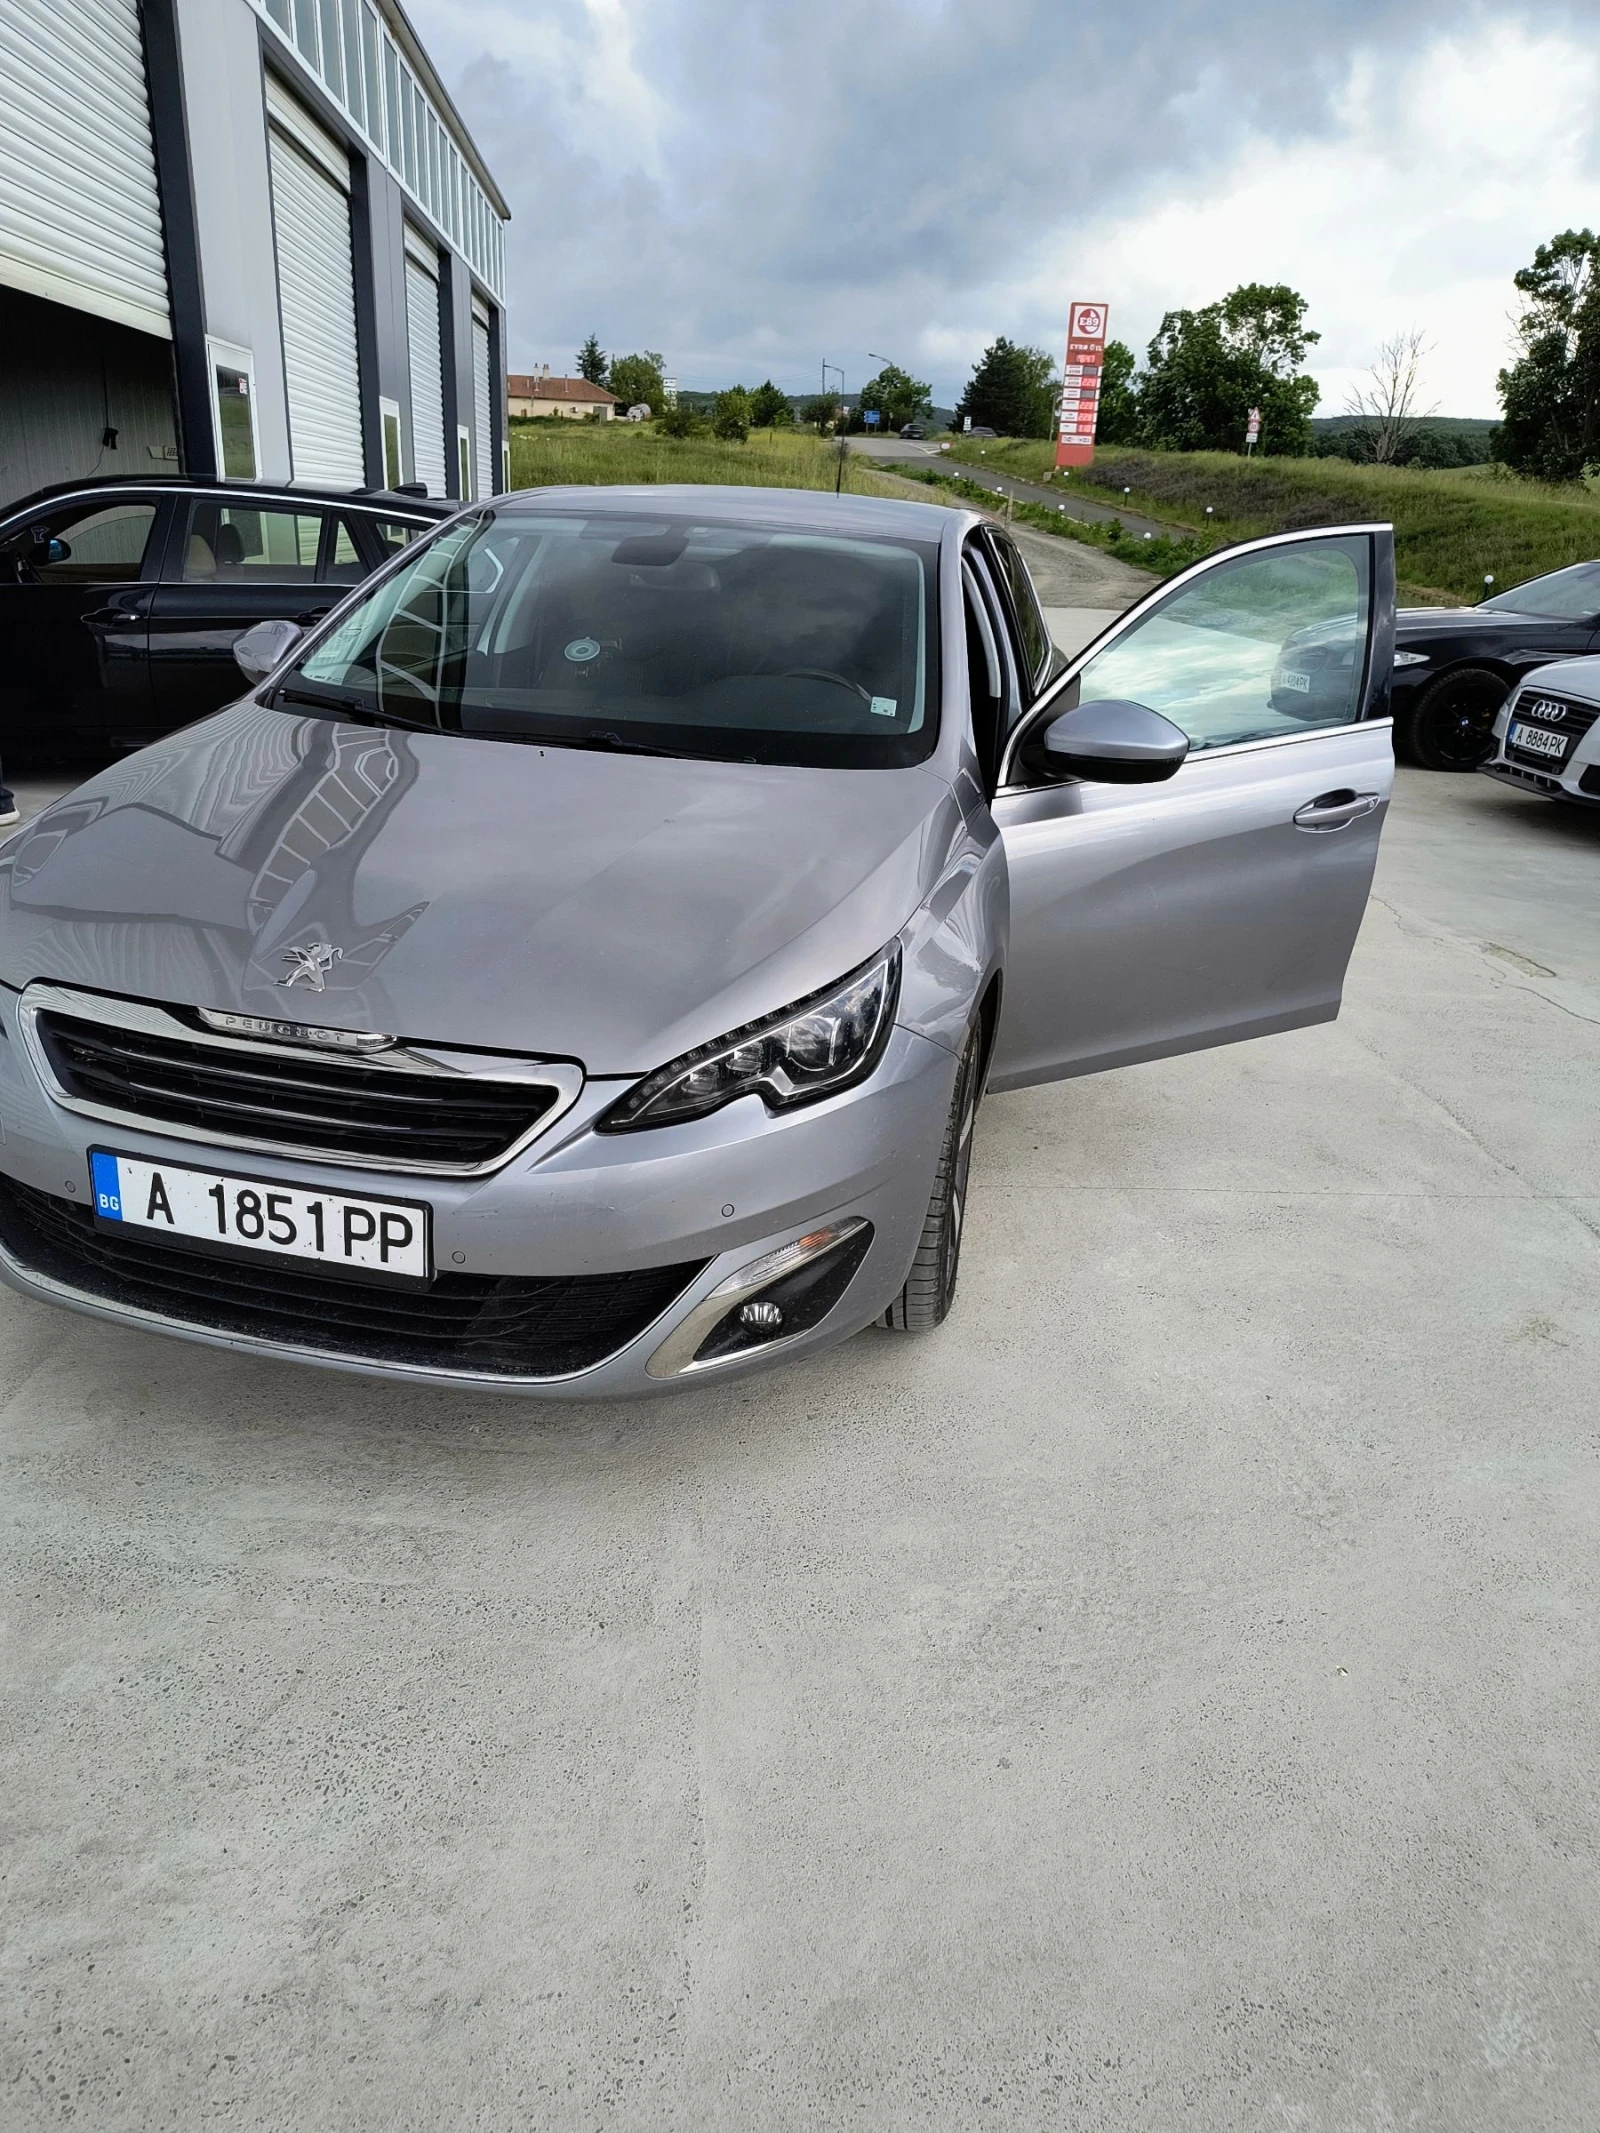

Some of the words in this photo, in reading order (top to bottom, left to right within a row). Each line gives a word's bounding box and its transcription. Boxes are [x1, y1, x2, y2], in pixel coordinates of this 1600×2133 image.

[1079, 317, 1099, 326] E89
[1516, 727, 1524, 742] A
[226, 1016, 346, 1042] PEUGEOT
[99, 1192, 120, 1212] BG
[146, 1171, 175, 1225] A
